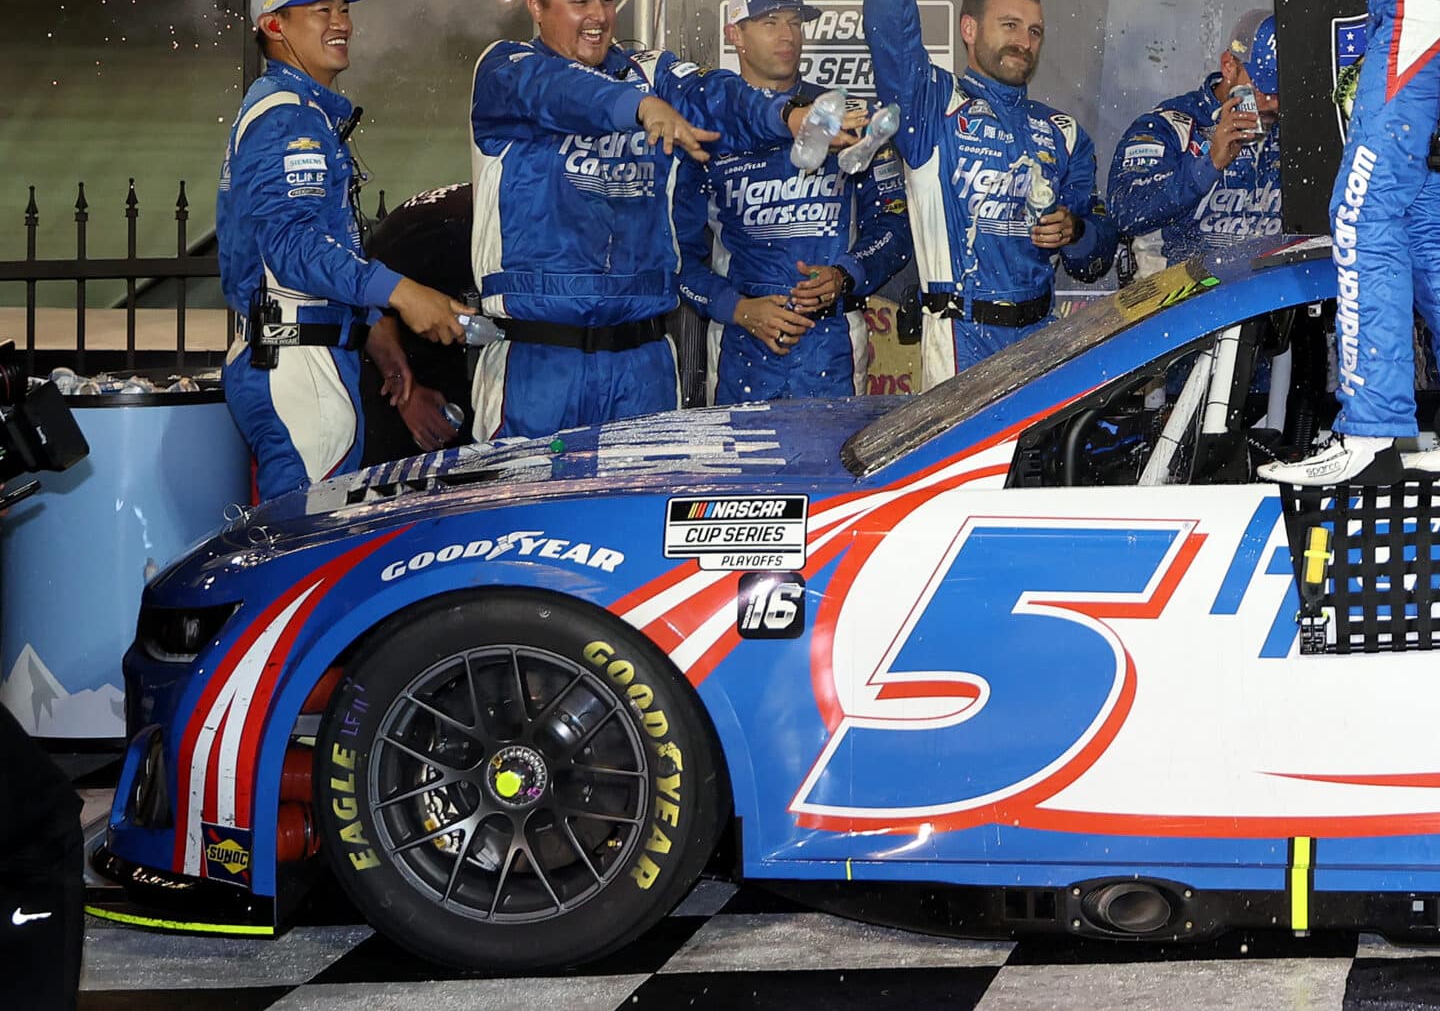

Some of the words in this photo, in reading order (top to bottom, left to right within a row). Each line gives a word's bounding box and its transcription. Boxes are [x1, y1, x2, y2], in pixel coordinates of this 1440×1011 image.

[563, 149, 656, 183] Cars.com
[724, 166, 848, 218] Hendrick
[742, 202, 843, 226] Cars.com
[1199, 211, 1283, 237] Cars.co
[711, 500, 787, 519] NASCAR
[684, 527, 723, 543] CUP
[722, 526, 787, 542] SERIES
[380, 530, 626, 583] GOODYEAR
[720, 555, 784, 567] PLAYOFFS
[748, 577, 804, 630] 16
[790, 516, 1206, 820] 5
[582, 640, 685, 891] GOODYEAR
[330, 741, 383, 872] EAGLE
